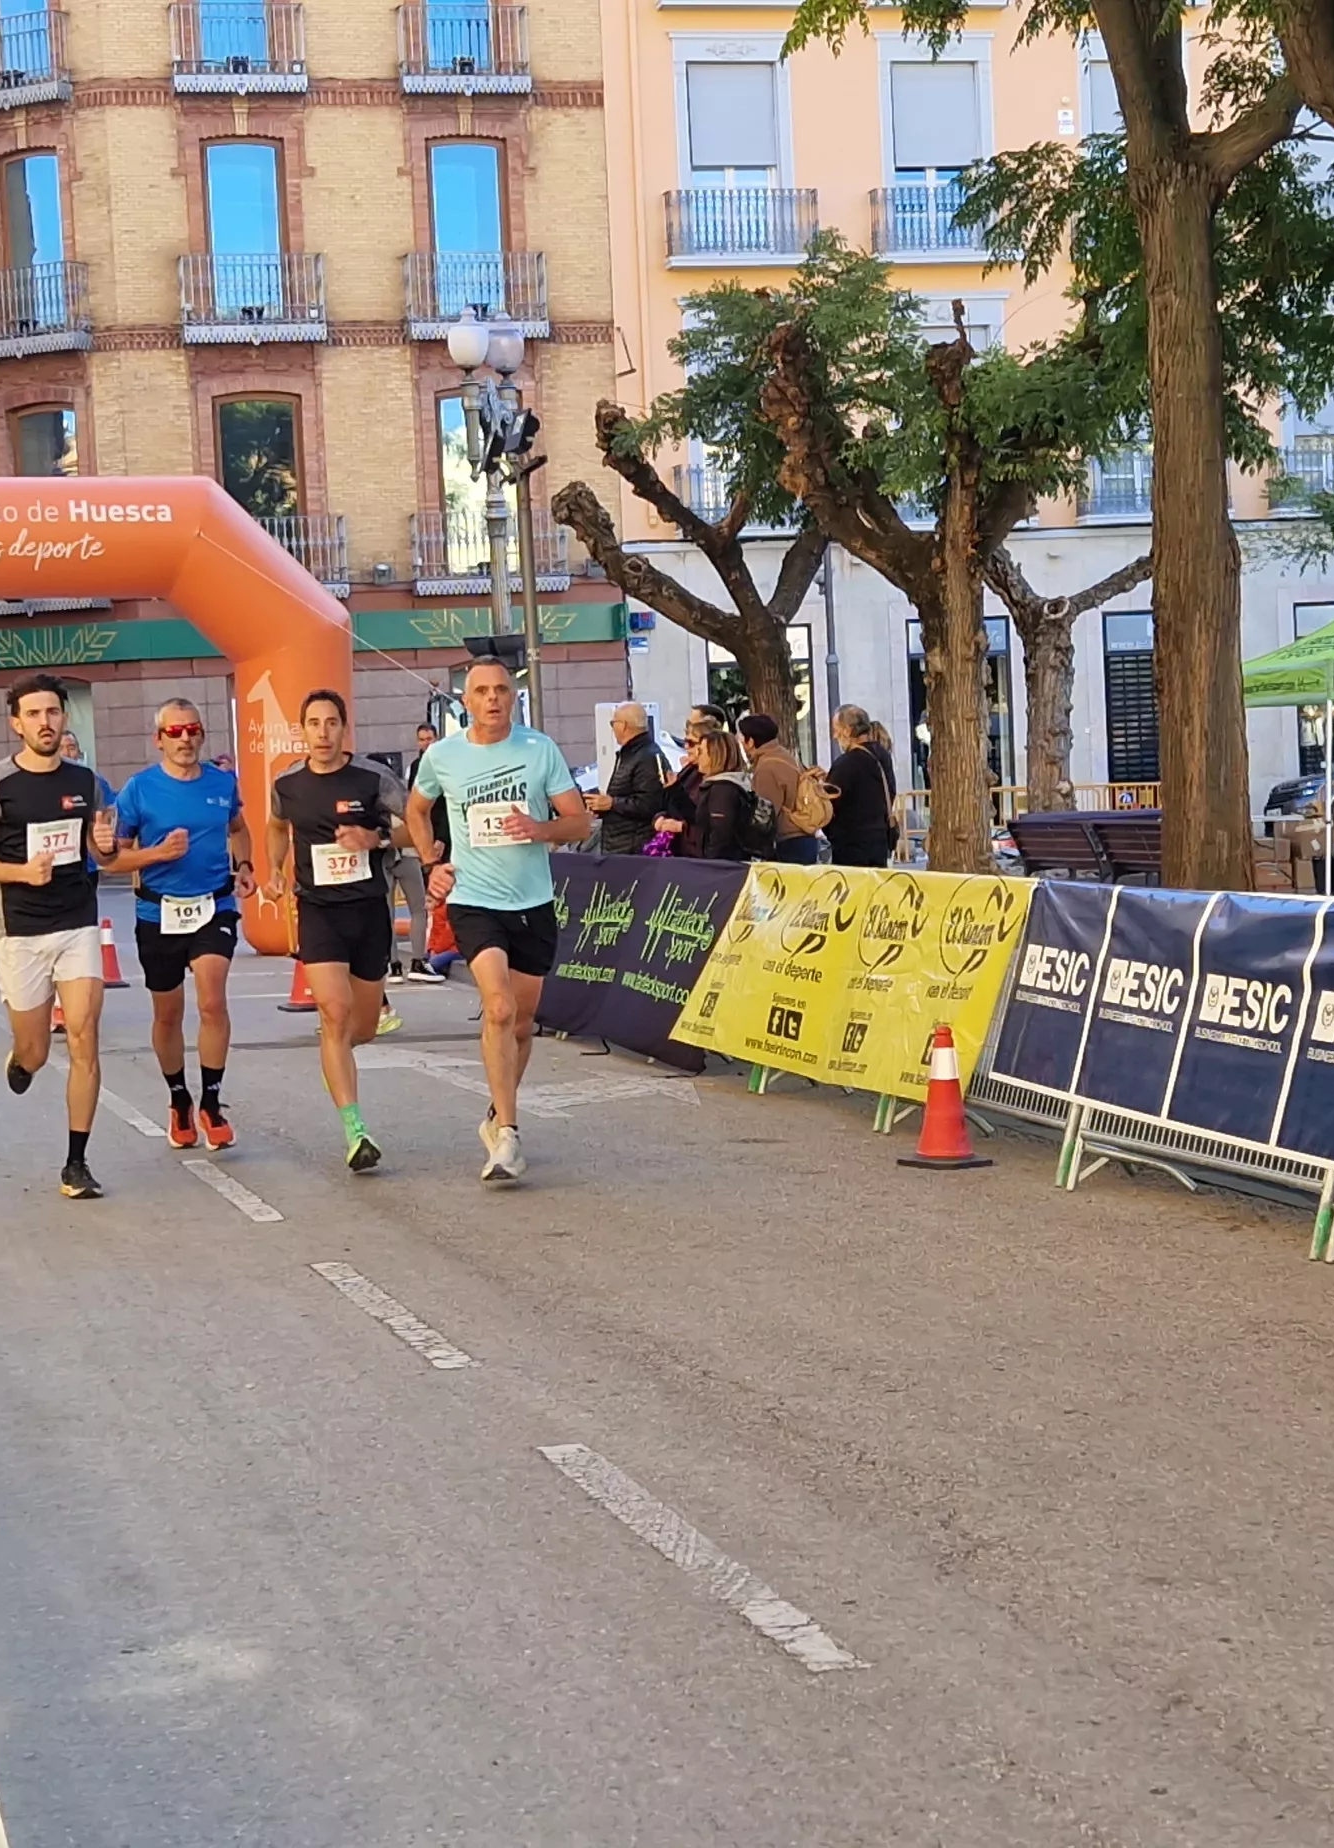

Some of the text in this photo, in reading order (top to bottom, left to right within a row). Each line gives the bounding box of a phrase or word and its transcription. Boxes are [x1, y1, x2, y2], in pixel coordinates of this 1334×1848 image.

[27, 500, 60, 522] de
[69, 500, 172, 522] Huesca
[9, 528, 105, 571] deporte
[248, 718, 304, 738] Ayunta
[249, 739, 310, 753] de Hues
[483, 817, 504, 830] 13
[43, 832, 69, 848] 377
[328, 855, 358, 869] 376
[174, 905, 202, 918] 101
[784, 960, 823, 983] deporte
[1036, 947, 1090, 996] ESIC
[1122, 961, 1184, 1014] ESIC
[1221, 977, 1292, 1034] ESIC
